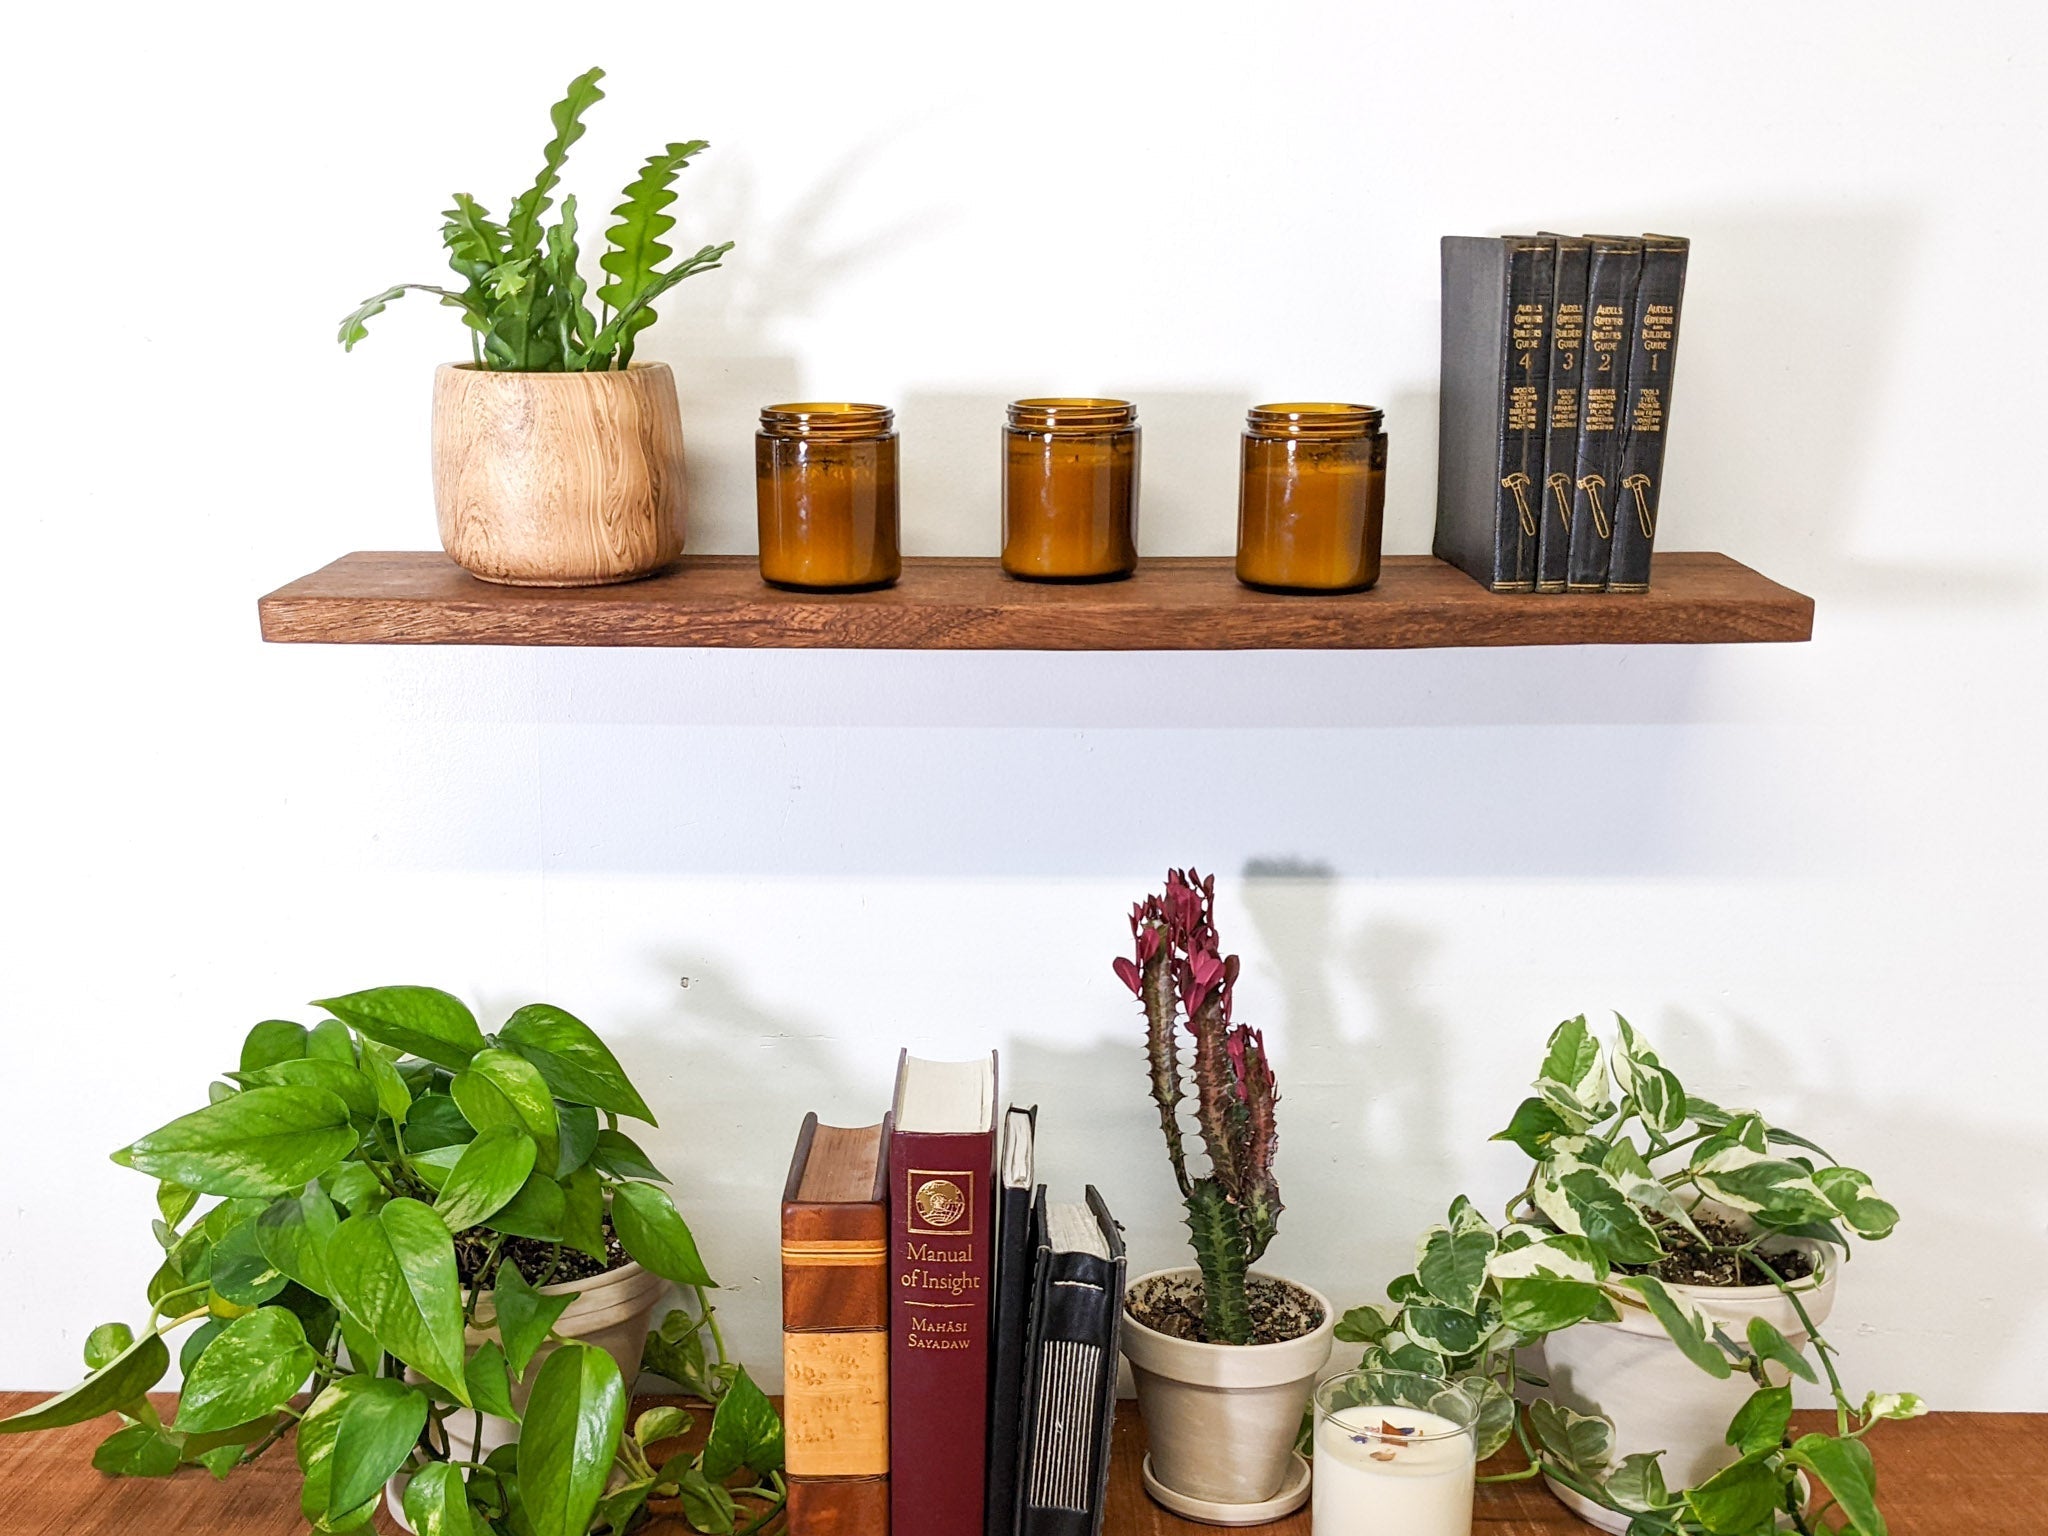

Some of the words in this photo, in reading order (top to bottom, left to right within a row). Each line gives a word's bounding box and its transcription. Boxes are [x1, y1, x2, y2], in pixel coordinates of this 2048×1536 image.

[1516, 304, 1543, 313] AUDLS
[1558, 303, 1583, 313] AUDELS
[1596, 304, 1623, 315] AUDELS
[1646, 303, 1673, 314] AUDELS
[1555, 329, 1583, 339] BUILDERS
[1591, 329, 1622, 341] BUILDERS
[1641, 328, 1672, 339] BUILDERS
[1557, 339, 1579, 350] GUIDE
[1593, 341, 1618, 351] GUIDE
[1643, 340, 1668, 351] GUIDE
[1519, 353, 1532, 370] 4
[1562, 352, 1574, 371] 3
[1598, 353, 1611, 371] 2
[1651, 353, 1659, 371] 1
[1514, 401, 1533, 409] STA
[907, 1242, 972, 1262] Manual
[901, 1270, 921, 1288] of
[923, 1270, 980, 1296] Insight
[908, 1333, 971, 1349] SAYADAW
